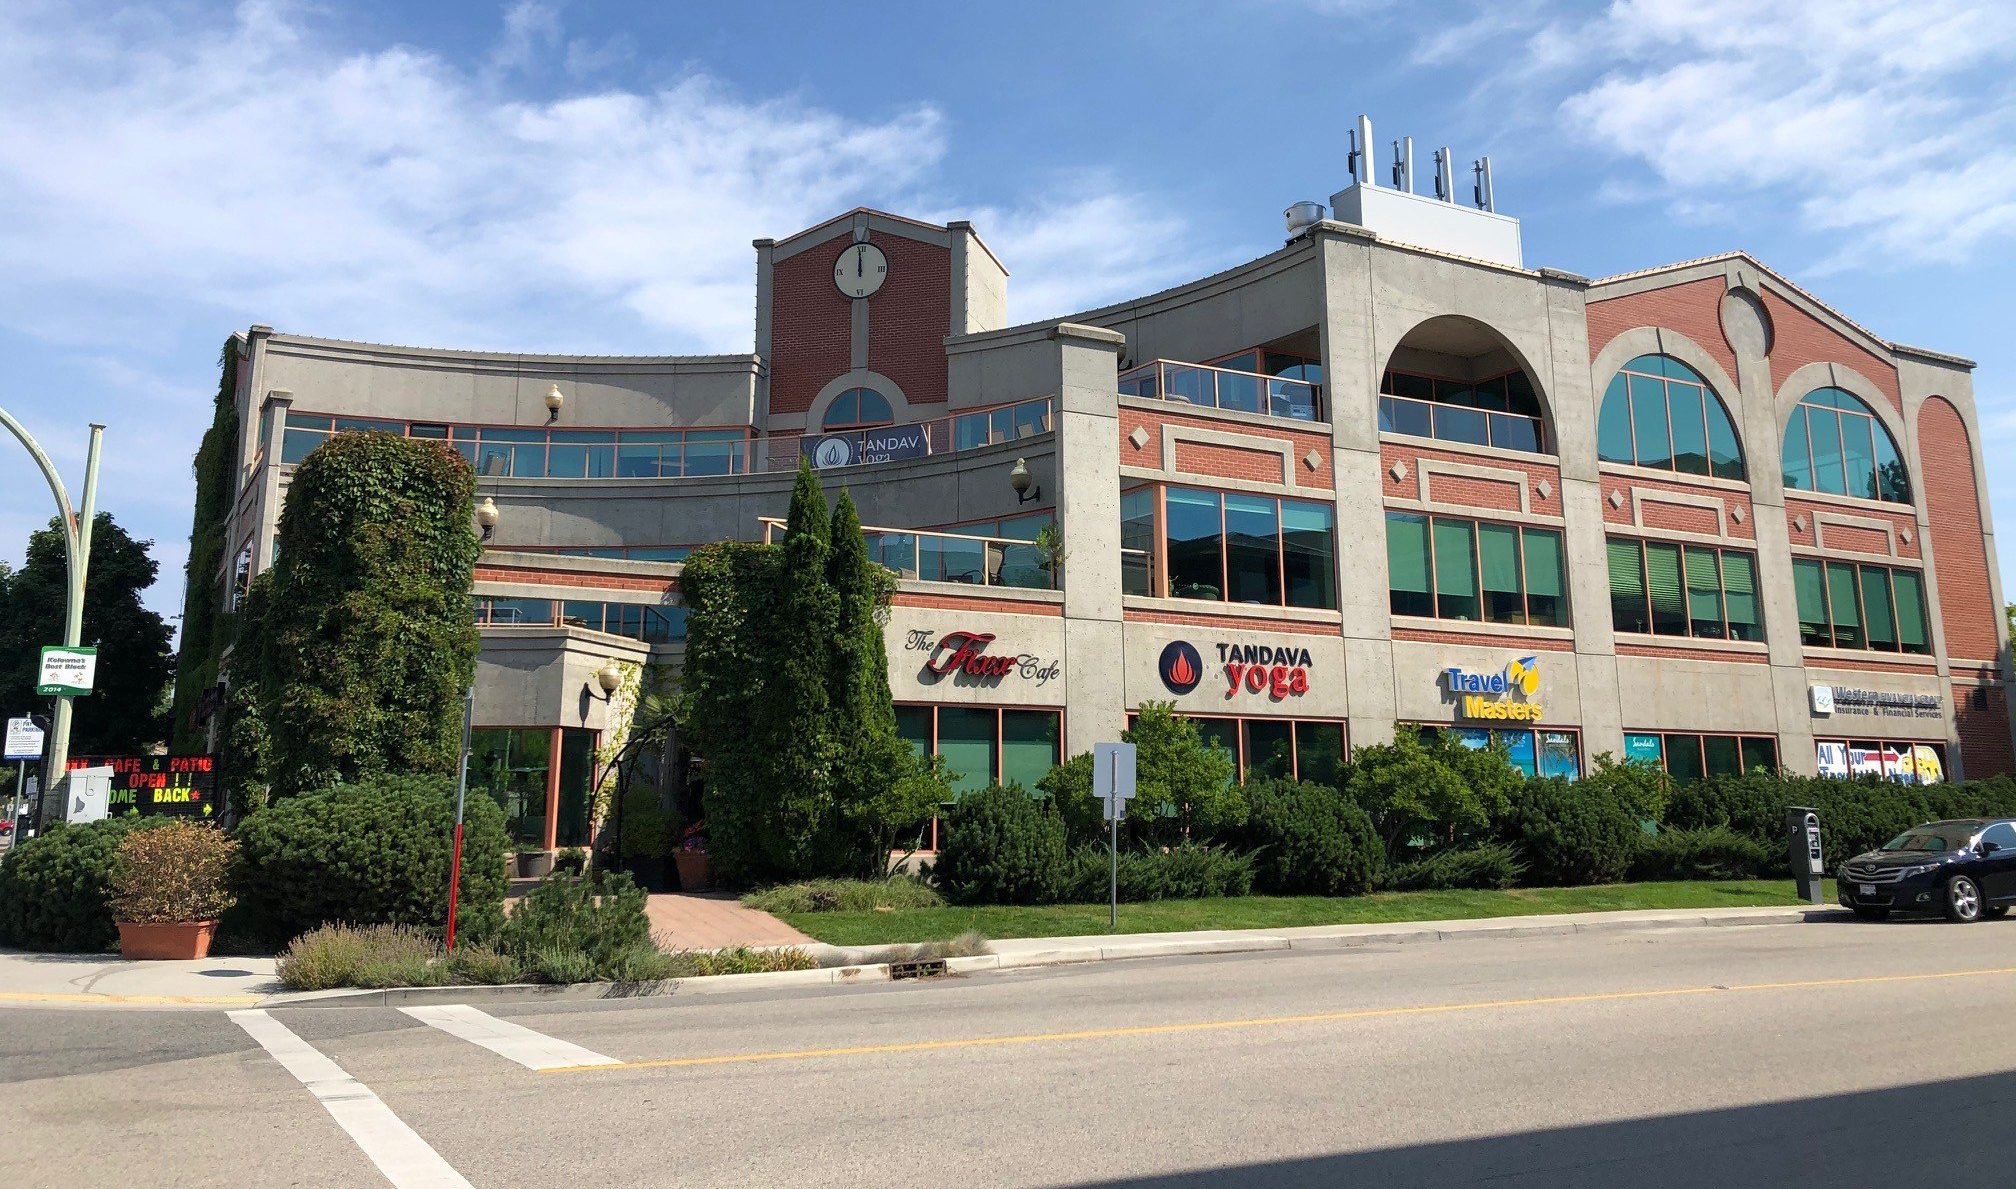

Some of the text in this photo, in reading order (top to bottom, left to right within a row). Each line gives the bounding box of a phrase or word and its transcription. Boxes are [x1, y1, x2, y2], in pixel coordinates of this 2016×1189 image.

[904, 629, 1060, 688] The Fixx Cafe
[1216, 642, 1313, 668] TANDAVA
[1225, 661, 1311, 699] yoga
[1449, 667, 1509, 693] Travel
[1835, 687, 1879, 700] Western
[1463, 695, 1543, 721] Masters
[1835, 705, 1869, 716] Insurance
[1882, 707, 1914, 718] Financial
[1914, 709, 1943, 719] Services
[170, 758, 212, 772] PATIO
[1818, 744, 1834, 765] All
[128, 773, 168, 788] OPEN
[153, 788, 191, 803] BACK
